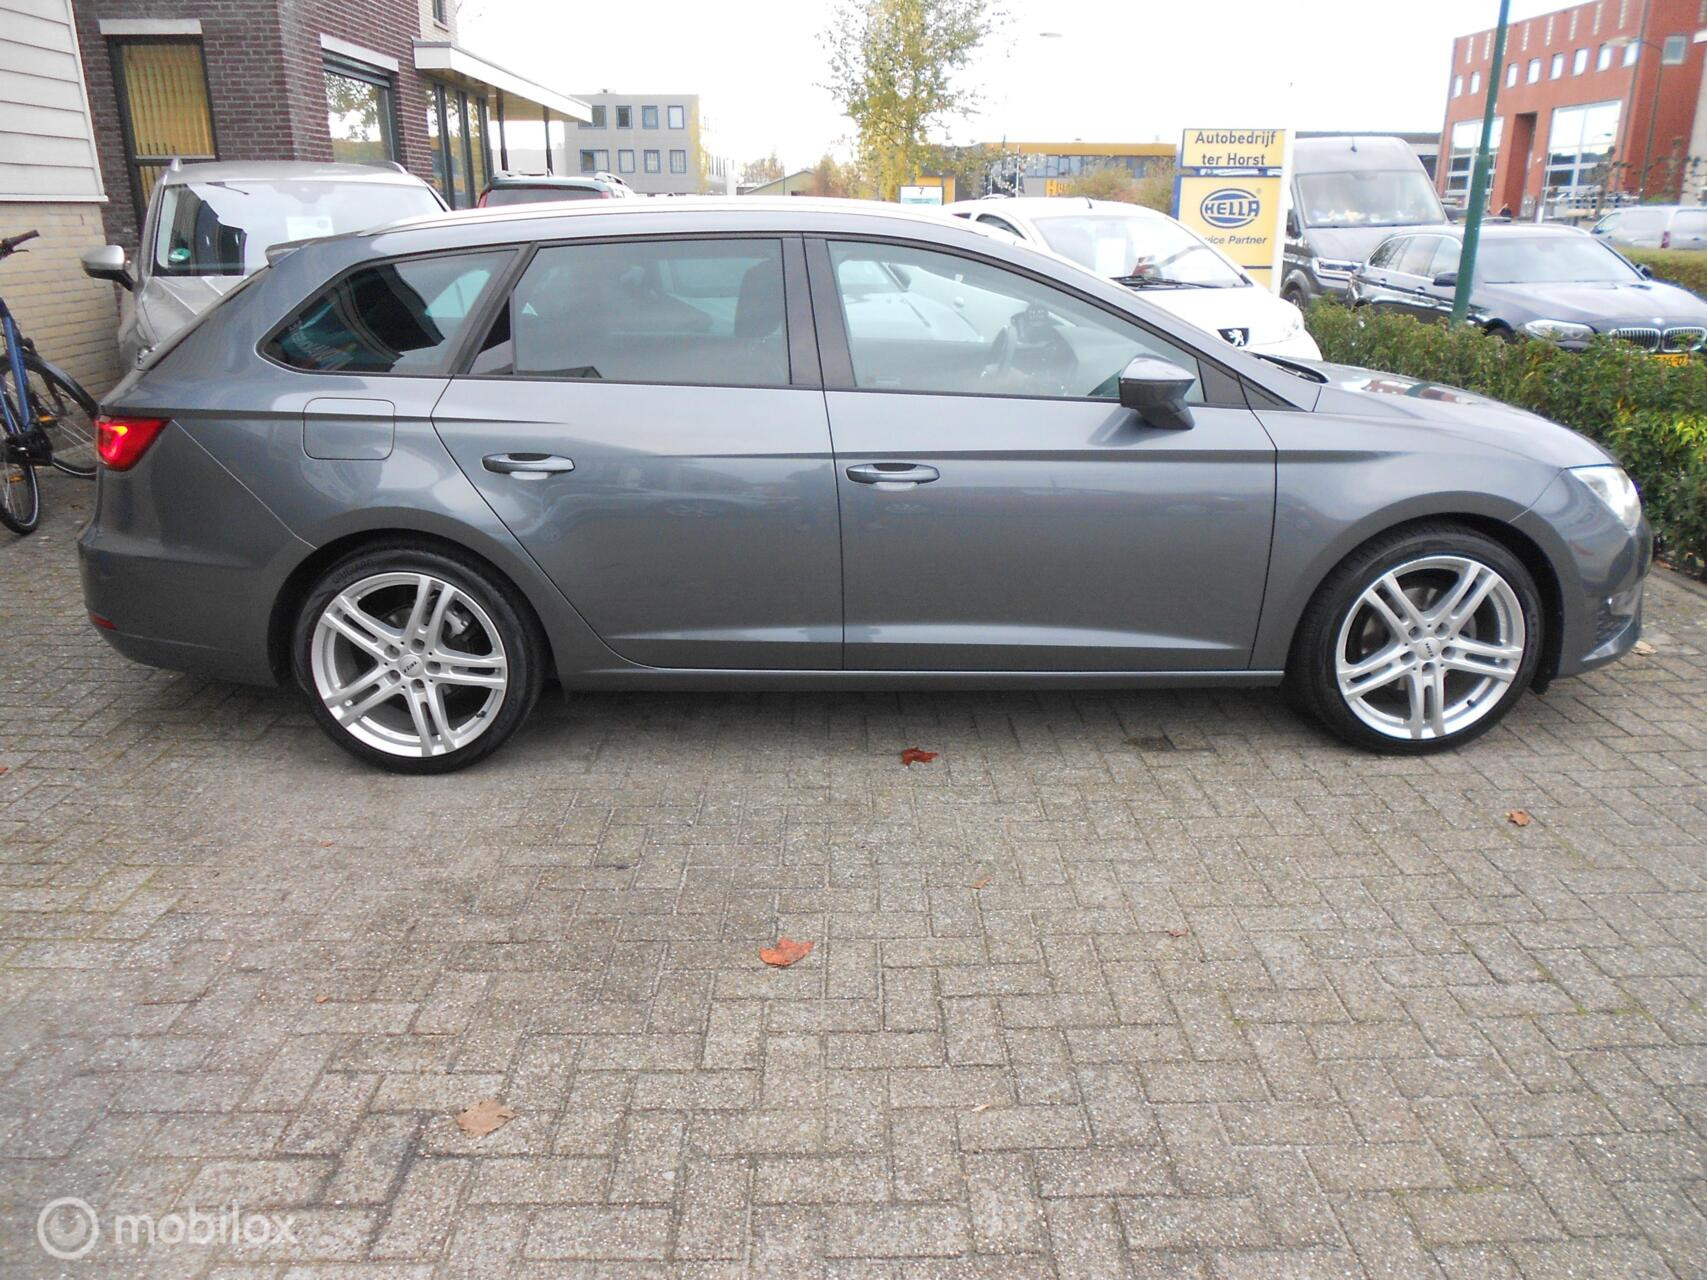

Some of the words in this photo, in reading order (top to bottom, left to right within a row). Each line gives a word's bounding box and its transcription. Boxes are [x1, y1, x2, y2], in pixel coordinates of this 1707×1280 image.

[1195, 131, 1276, 148] Autobedrijf
[1202, 154, 1222, 165] ter
[1227, 153, 1265, 165] Horst
[1204, 200, 1260, 217] HELLA
[1228, 235, 1267, 244] Partner
